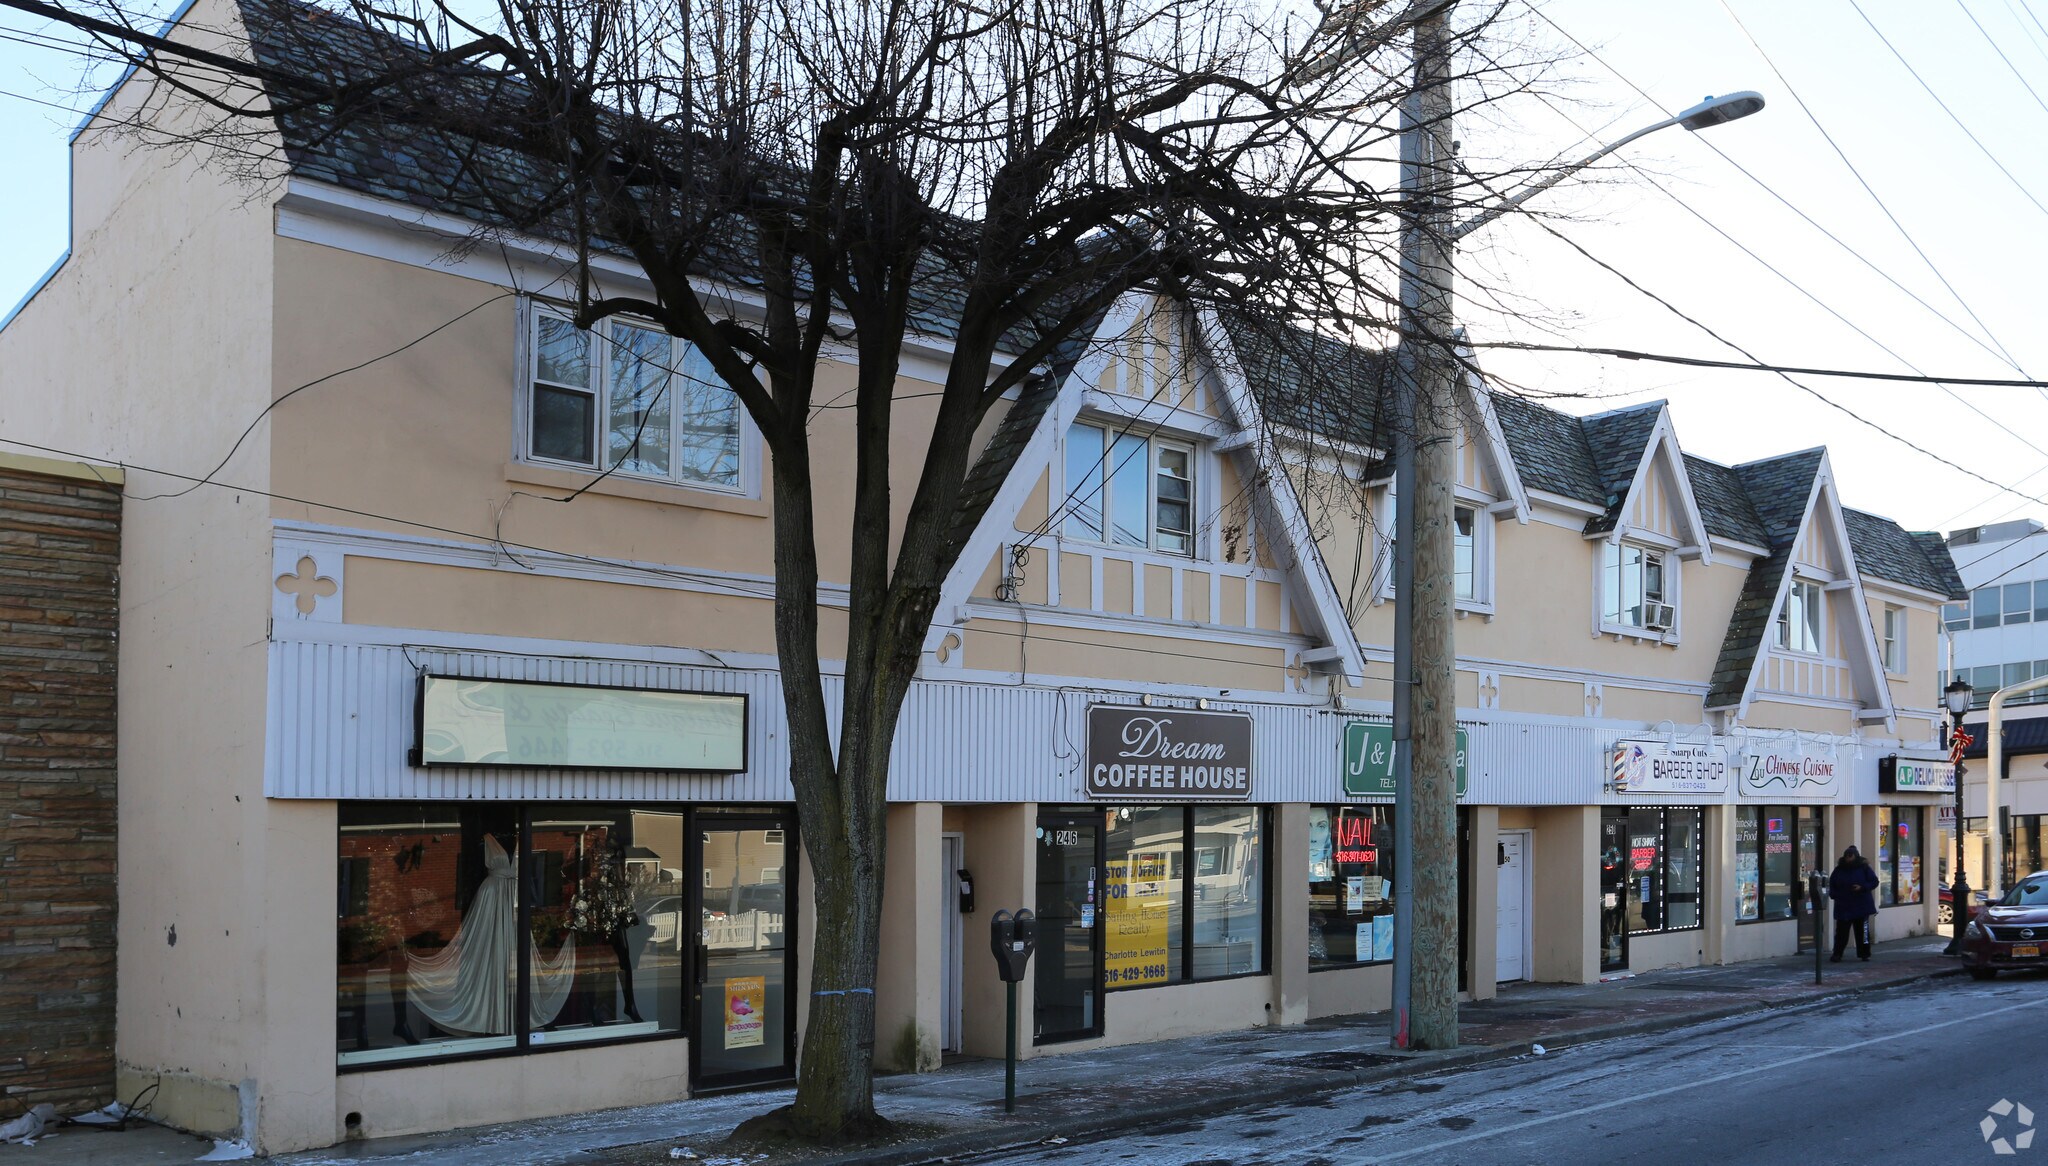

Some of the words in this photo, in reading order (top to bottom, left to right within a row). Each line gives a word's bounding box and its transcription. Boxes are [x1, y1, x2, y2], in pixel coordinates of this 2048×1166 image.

[1118, 717, 1226, 760] Dream
[1350, 732, 1369, 775] J
[1370, 742, 1385, 765] &
[1093, 763, 1175, 788] COFFEE
[1180, 766, 1246, 789] HOUSE
[1653, 759, 1693, 779] BARBER
[1697, 762, 1724, 780] SHOP
[1057, 831, 1077, 845] 246
[1337, 817, 1376, 846] NAIL
[1743, 830, 1757, 841] Food
[1631, 848, 1655, 858] BARBER
[1106, 883, 1127, 899] FOR
[1141, 908, 1166, 920] Home
[1118, 922, 1150, 937] Realty
[1105, 949, 1137, 961] Charlotte
[1141, 946, 1166, 957] Lewitin
[1105, 964, 1166, 983] 516-429-3668
